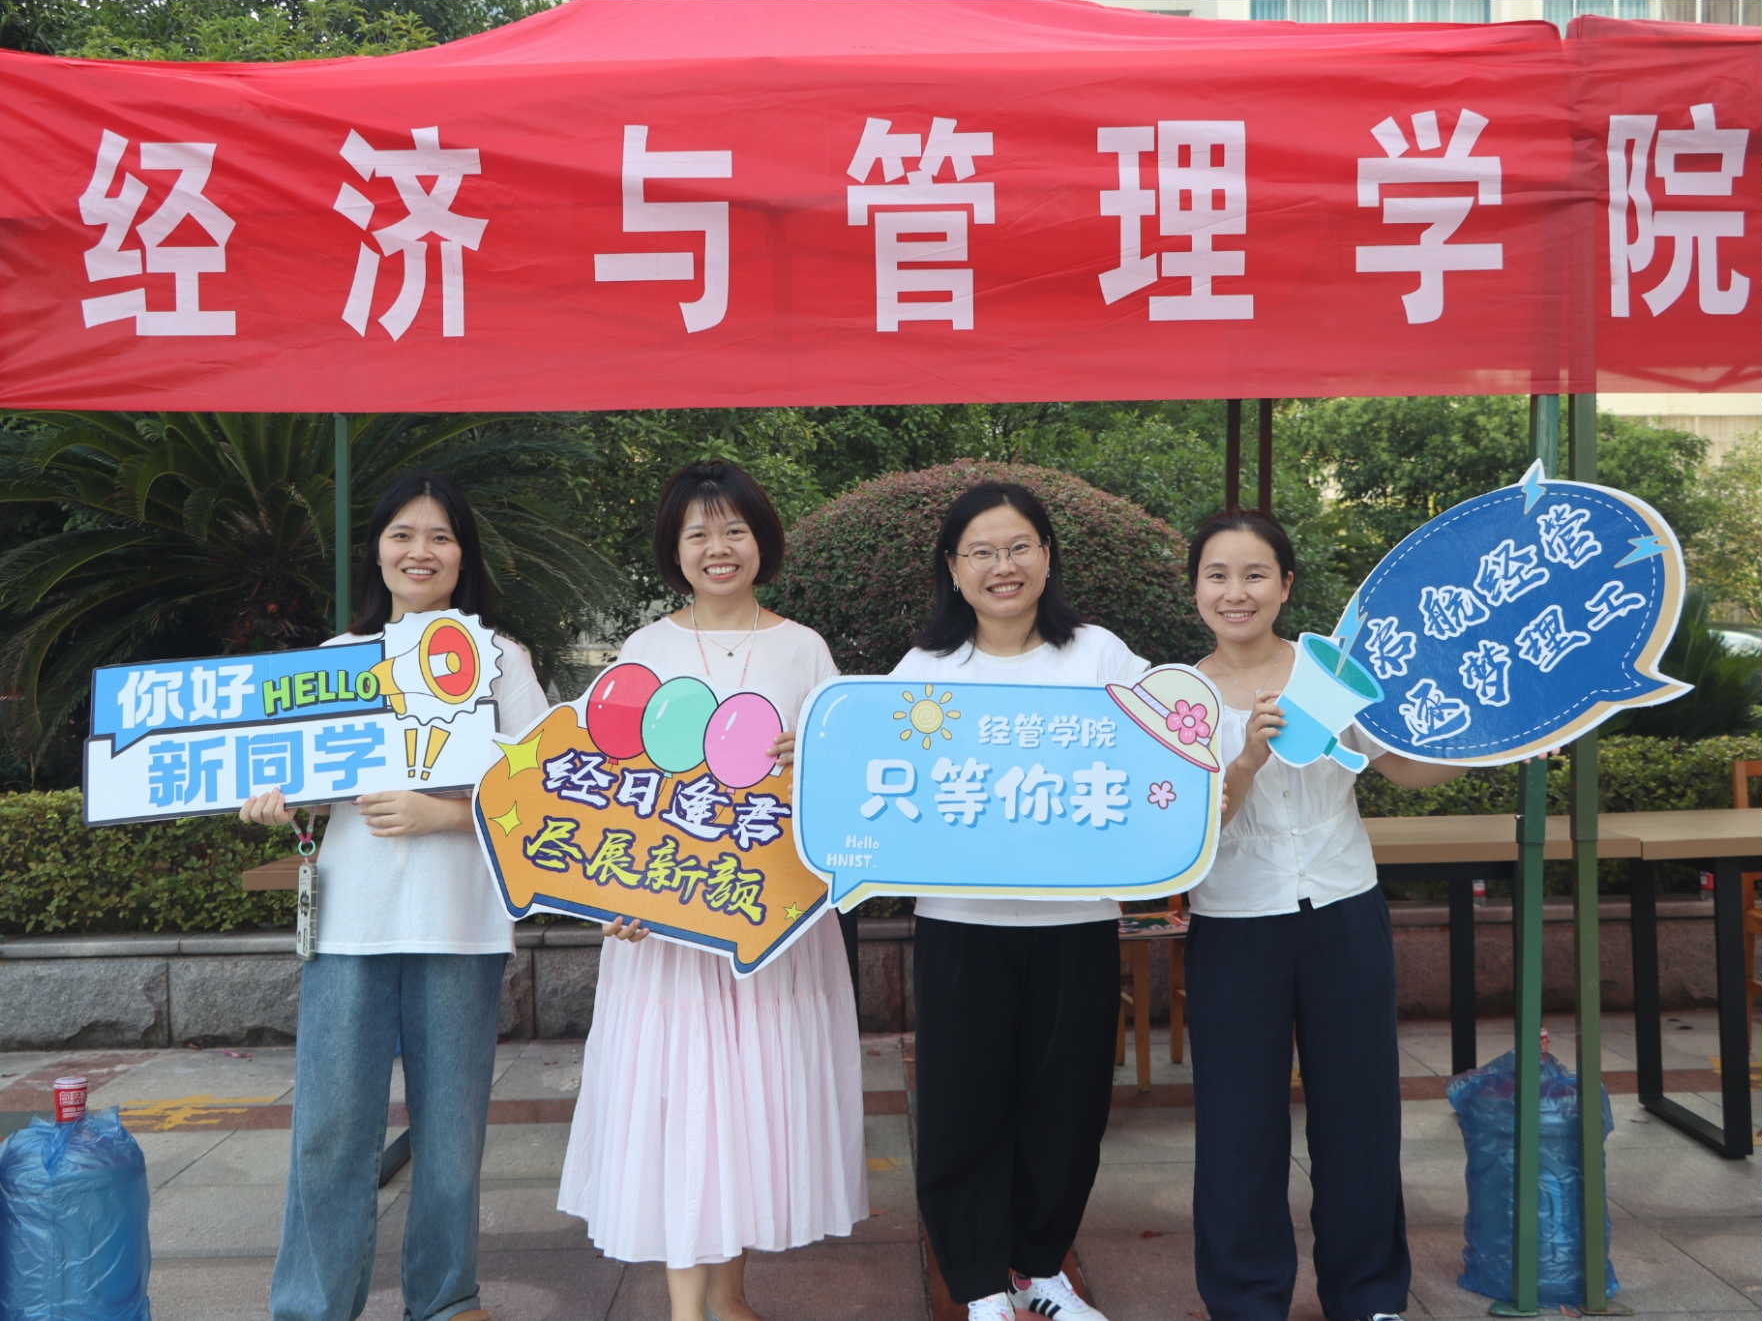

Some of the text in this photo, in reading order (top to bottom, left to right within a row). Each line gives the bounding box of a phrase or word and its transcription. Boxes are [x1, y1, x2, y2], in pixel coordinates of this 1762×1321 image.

[79, 103, 1750, 342] 经济与管理学院
[1365, 504, 1602, 679] 启航经管
[117, 664, 380, 729] 你好 HELLO
[1399, 580, 1647, 746] 逐梦理工
[148, 721, 386, 808] 新同学
[978, 713, 1116, 748] 经管学院
[546, 751, 792, 849] 经日逢君
[860, 757, 1128, 827] 只等你来
[526, 819, 763, 922] 尽展新颜
[845, 835, 880, 850] Hello
